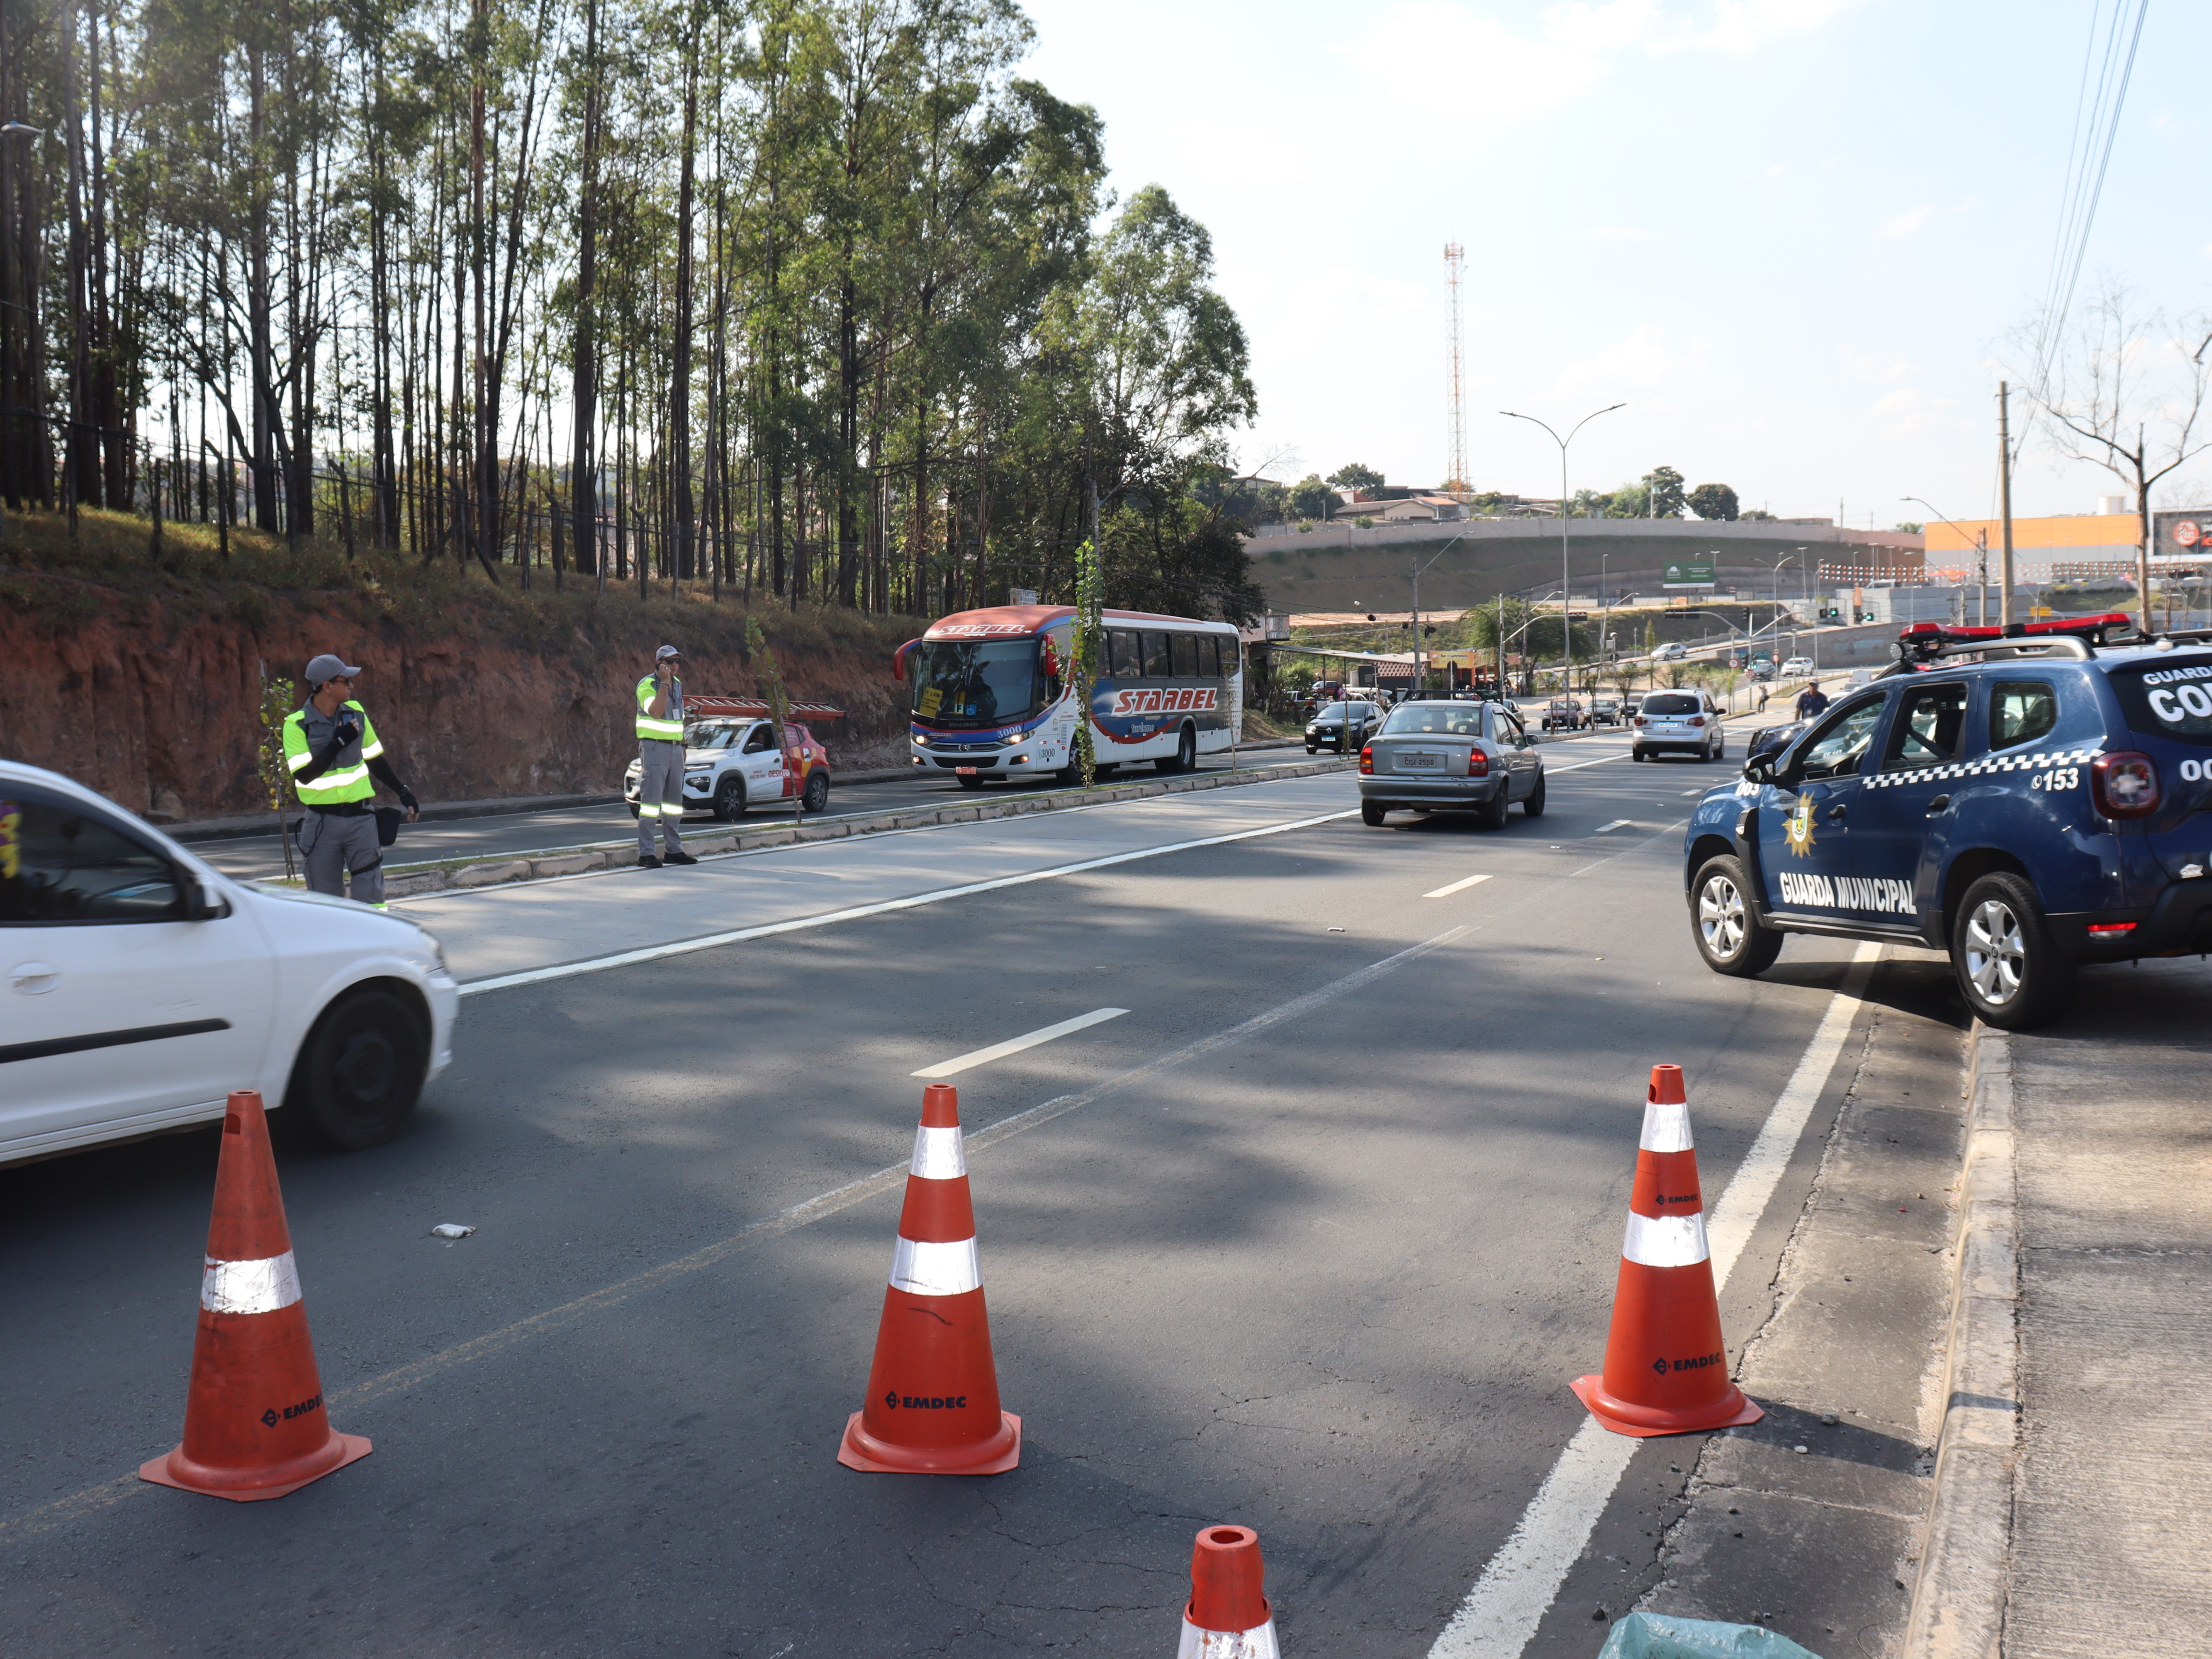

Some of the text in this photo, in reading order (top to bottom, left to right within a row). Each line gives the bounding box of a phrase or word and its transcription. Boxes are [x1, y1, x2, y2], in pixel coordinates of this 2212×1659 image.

[937, 625, 1025, 635] STARBEL
[2142, 665, 2212, 685] GUARD
[1112, 688, 1218, 715] STARBEL
[997, 725, 1022, 738] 3000
[1131, 722, 1155, 733] turismo
[1041, 748, 1055, 758] 3000
[2043, 767, 2079, 791] 153
[1735, 781, 1760, 796] 003
[1780, 872, 1918, 915] GUARDA MUNICIPAL
[1668, 1194, 1698, 1203] EMDEC
[1673, 1352, 1720, 1371] EMDEC
[903, 1396, 966, 1409] EMDEC
